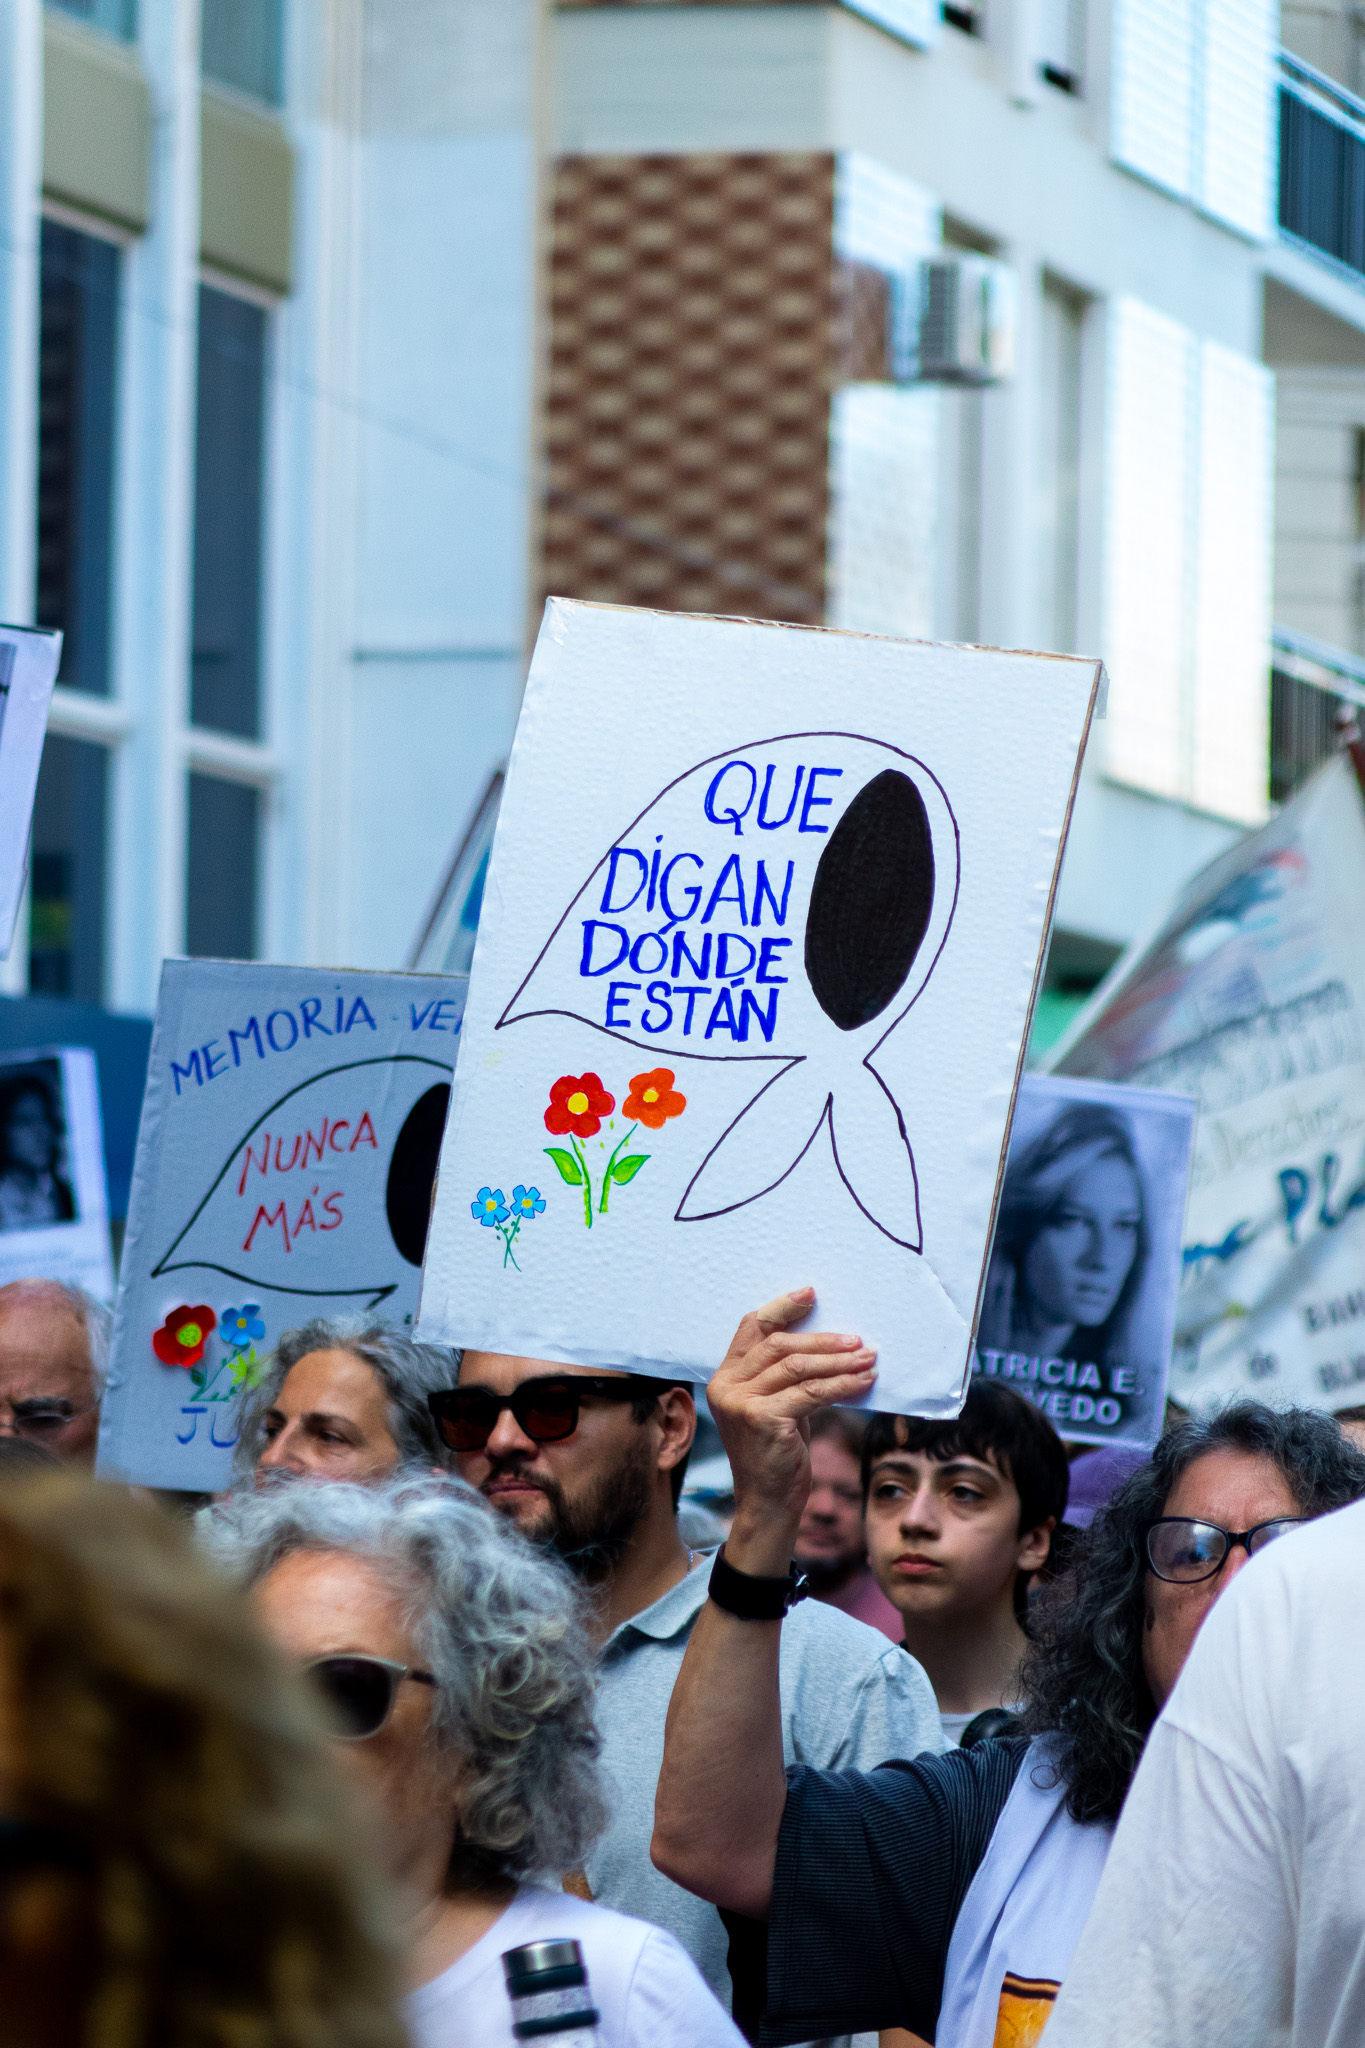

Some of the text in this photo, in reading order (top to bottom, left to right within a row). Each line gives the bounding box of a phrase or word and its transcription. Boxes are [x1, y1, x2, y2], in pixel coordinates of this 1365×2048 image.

[704, 760, 843, 836] QUE
[579, 919, 793, 984] DÓNDE
[605, 977, 779, 1042] ESTÁN
[238, 1111, 378, 1197] NUNCA
[243, 1185, 344, 1254] MÁS
[176, 1406, 241, 1449] JU
[1022, 1388, 1122, 1426] VEDO
